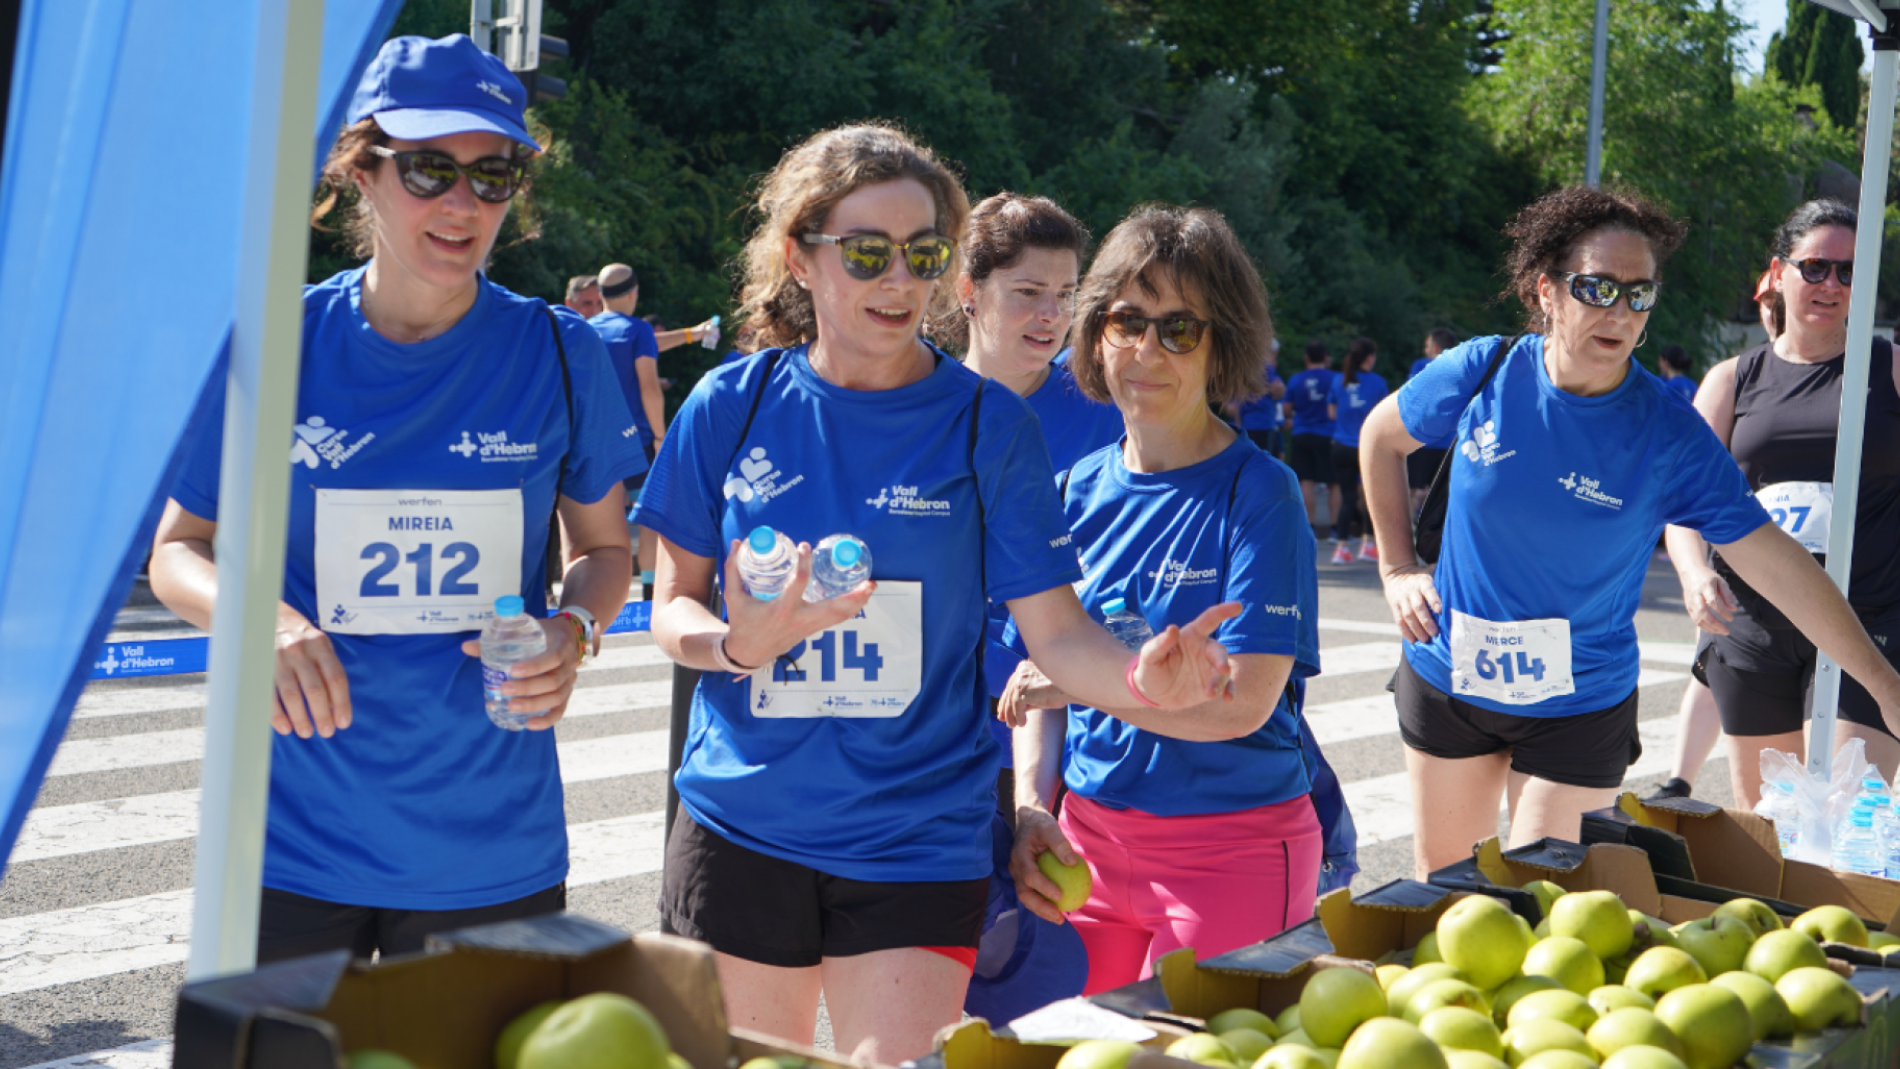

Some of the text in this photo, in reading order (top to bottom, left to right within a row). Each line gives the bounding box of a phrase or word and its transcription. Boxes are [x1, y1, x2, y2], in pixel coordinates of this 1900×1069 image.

[477, 430, 507, 444] Vall
[1580, 475, 1600, 489] Vall
[892, 485, 918, 496] Vall
[1576, 485, 1623, 506] d'Hebron
[398, 497, 442, 506] werfen
[889, 496, 951, 509] d'Hebron
[388, 517, 453, 531] MIREIA
[359, 541, 480, 597] 212
[1485, 634, 1524, 646] MERCE
[122, 645, 144, 656] Vall
[772, 630, 884, 682] 214
[121, 656, 173, 668] d'Hebron
[1475, 648, 1546, 684] 614
